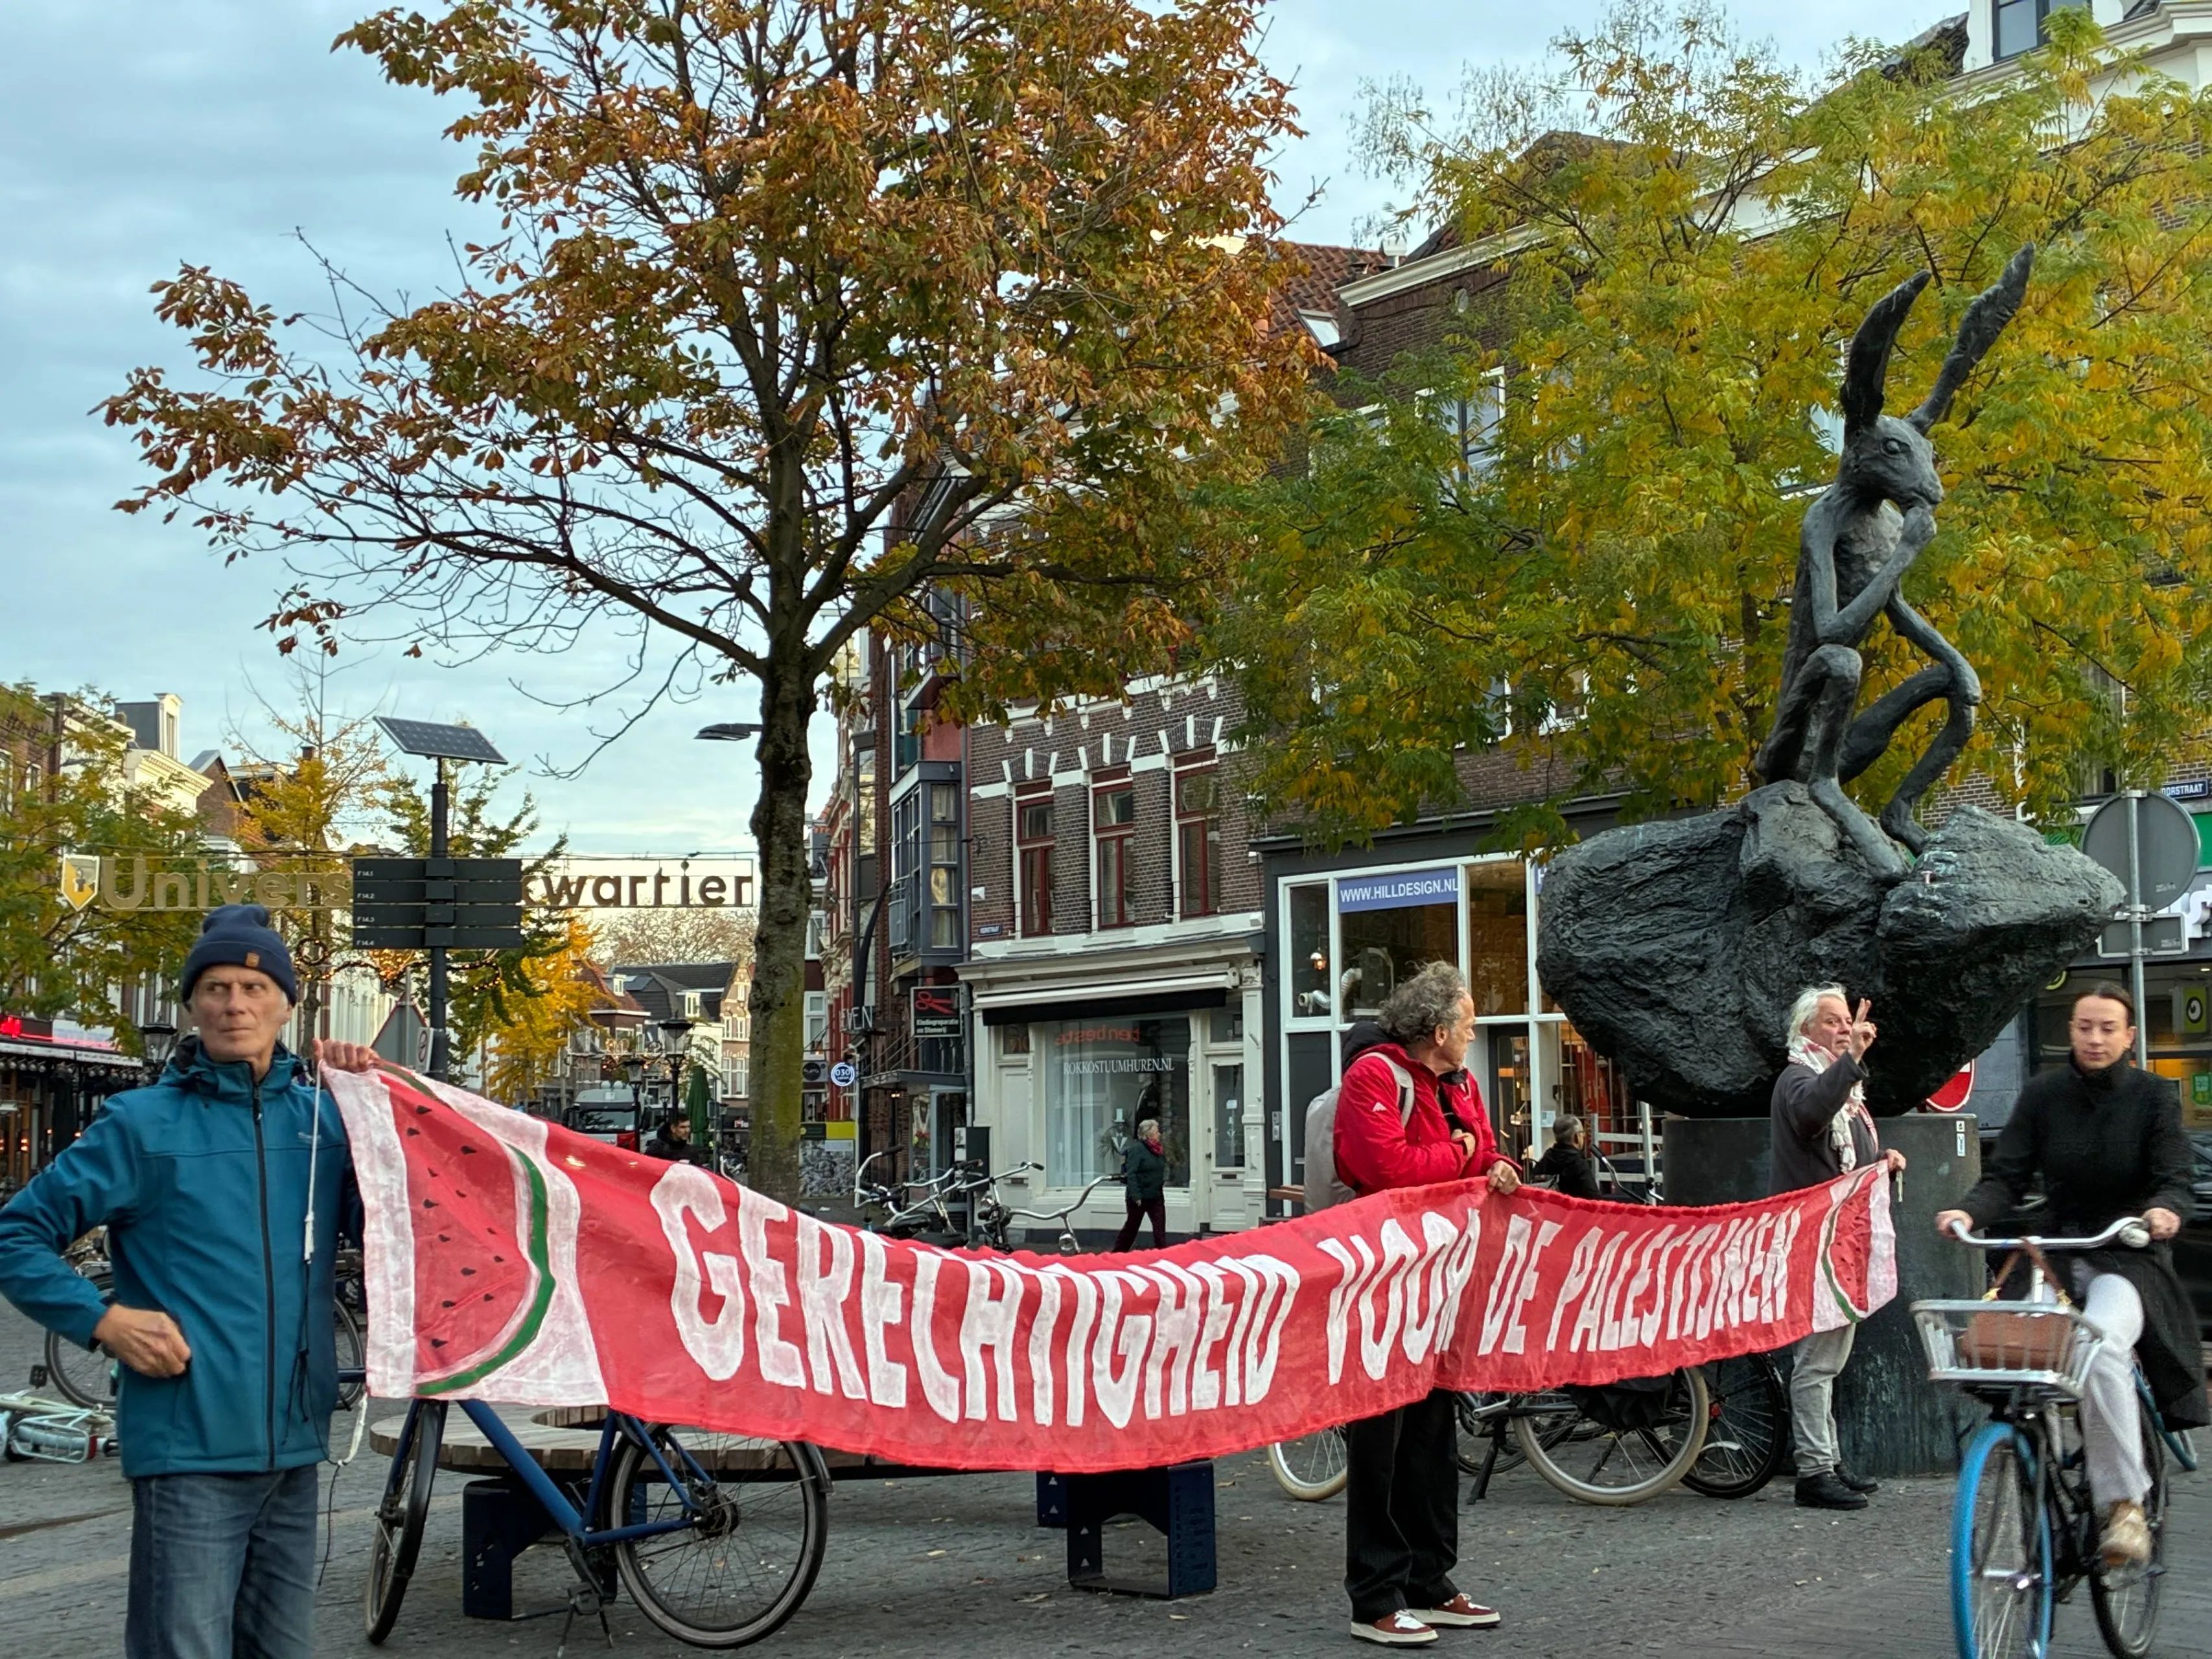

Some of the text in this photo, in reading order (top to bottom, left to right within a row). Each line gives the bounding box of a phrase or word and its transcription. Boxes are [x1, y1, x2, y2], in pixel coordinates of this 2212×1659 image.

[2160, 783, 2204, 796] OORSTRAAT
[1340, 879, 1458, 903] WWW.HILLDESIGN.NL
[1064, 1058, 1174, 1075] ROKKOSTUUMHUREN.NL
[1476, 1214, 1564, 1356] DE
[1546, 1201, 1805, 1352] PALESTIJNEN
